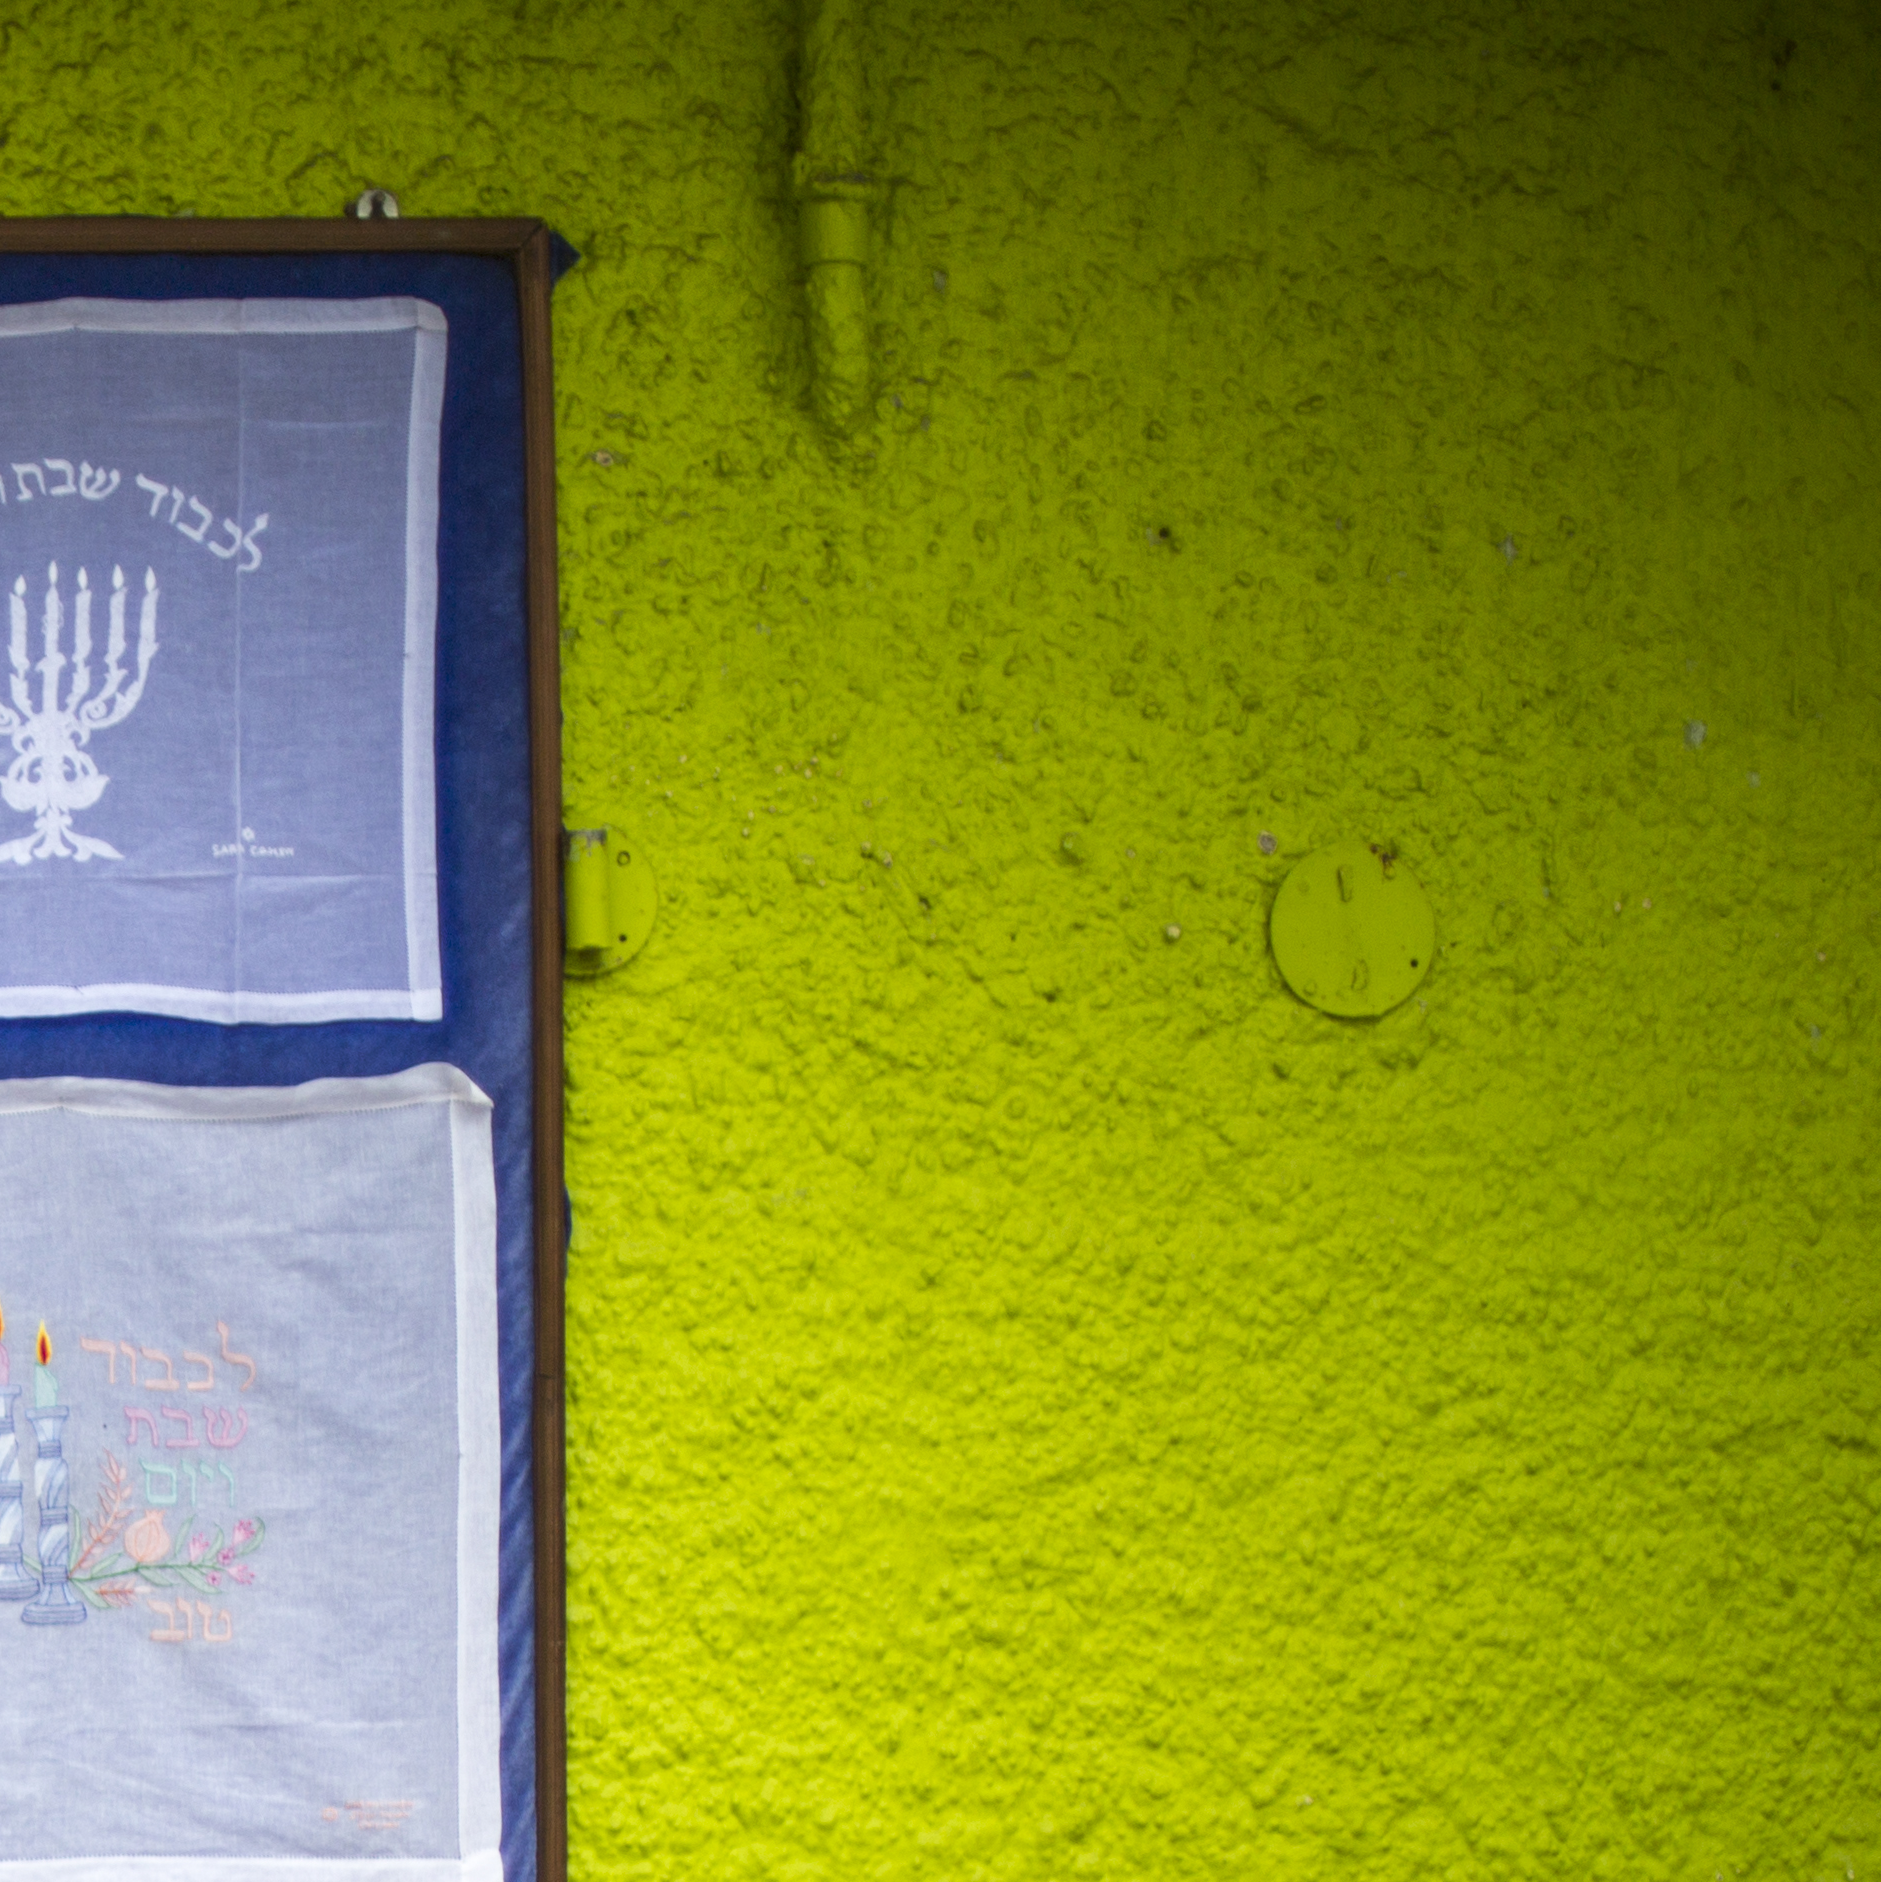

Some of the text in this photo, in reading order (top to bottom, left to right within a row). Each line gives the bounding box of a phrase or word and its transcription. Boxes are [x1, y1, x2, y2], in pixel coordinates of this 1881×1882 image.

[11, 457, 120, 500] שבת
[136, 473, 269, 573] לכבוד
[80, 1319, 257, 1392] לכבוד
[123, 1404, 249, 1448] שבת
[139, 1457, 235, 1508] ויום
[148, 1596, 232, 1642] טוב
